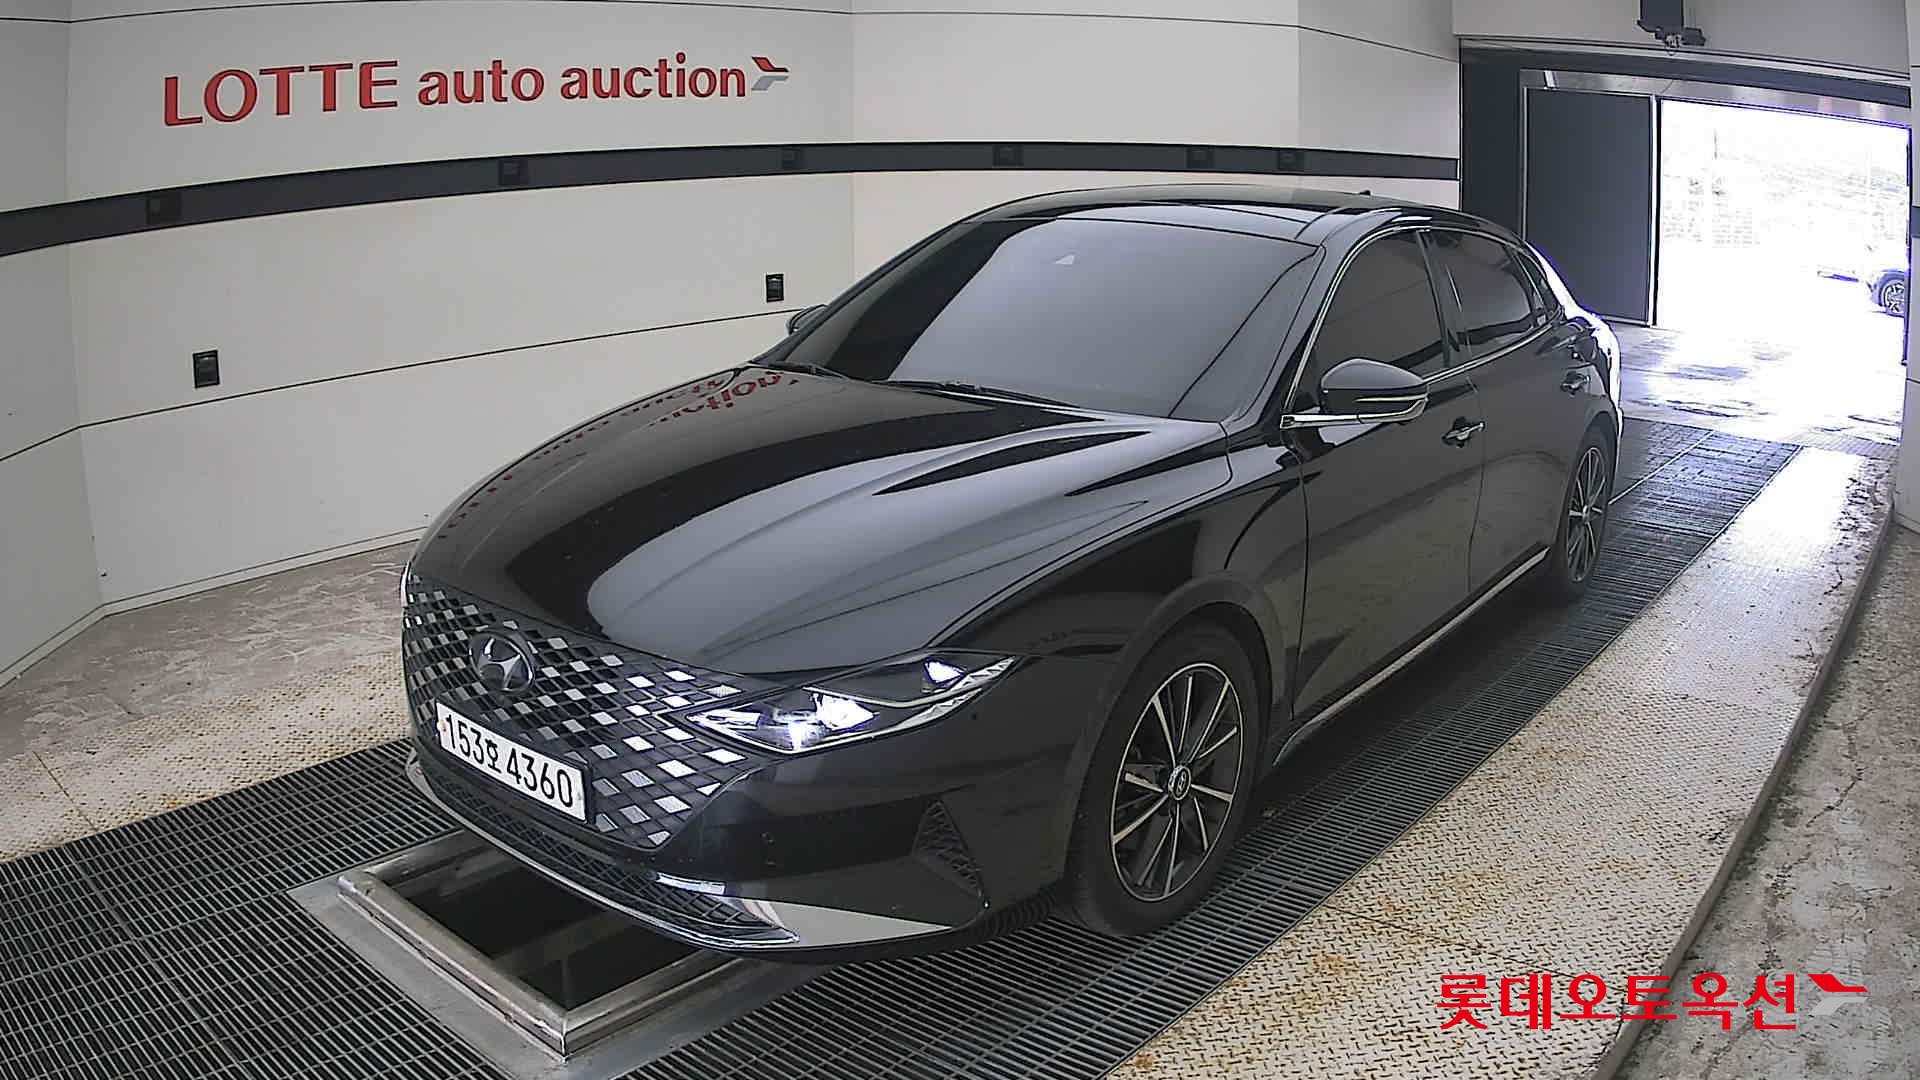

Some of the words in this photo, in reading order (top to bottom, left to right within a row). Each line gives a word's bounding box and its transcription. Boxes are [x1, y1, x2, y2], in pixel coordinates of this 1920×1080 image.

[163, 60, 398, 127] LOTTE
[417, 59, 545, 105] auto
[560, 51, 747, 99] auction
[506, 747, 574, 808] 4360
